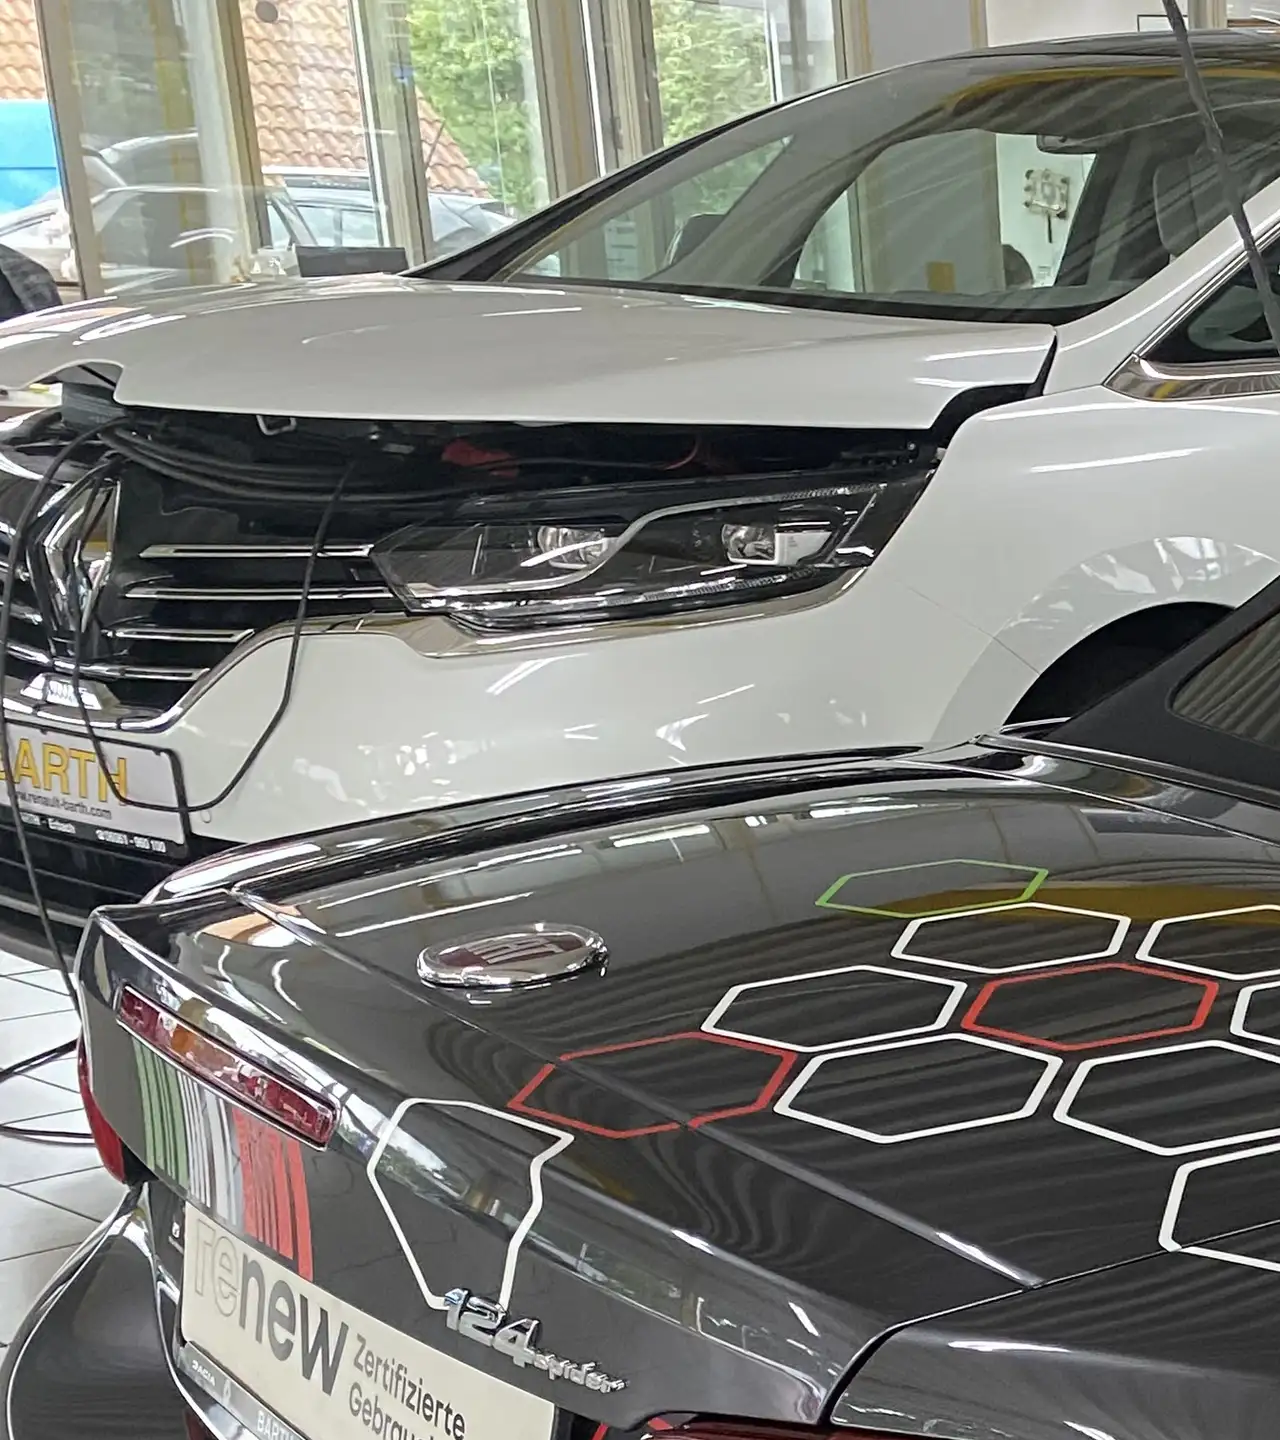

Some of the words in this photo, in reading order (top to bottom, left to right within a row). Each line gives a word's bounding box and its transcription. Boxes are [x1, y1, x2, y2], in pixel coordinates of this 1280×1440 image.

[0, 737, 128, 803] ARTH
[194, 1218, 350, 1397] renew
[446, 1288, 540, 1368] 124
[534, 1352, 630, 1394] spider
